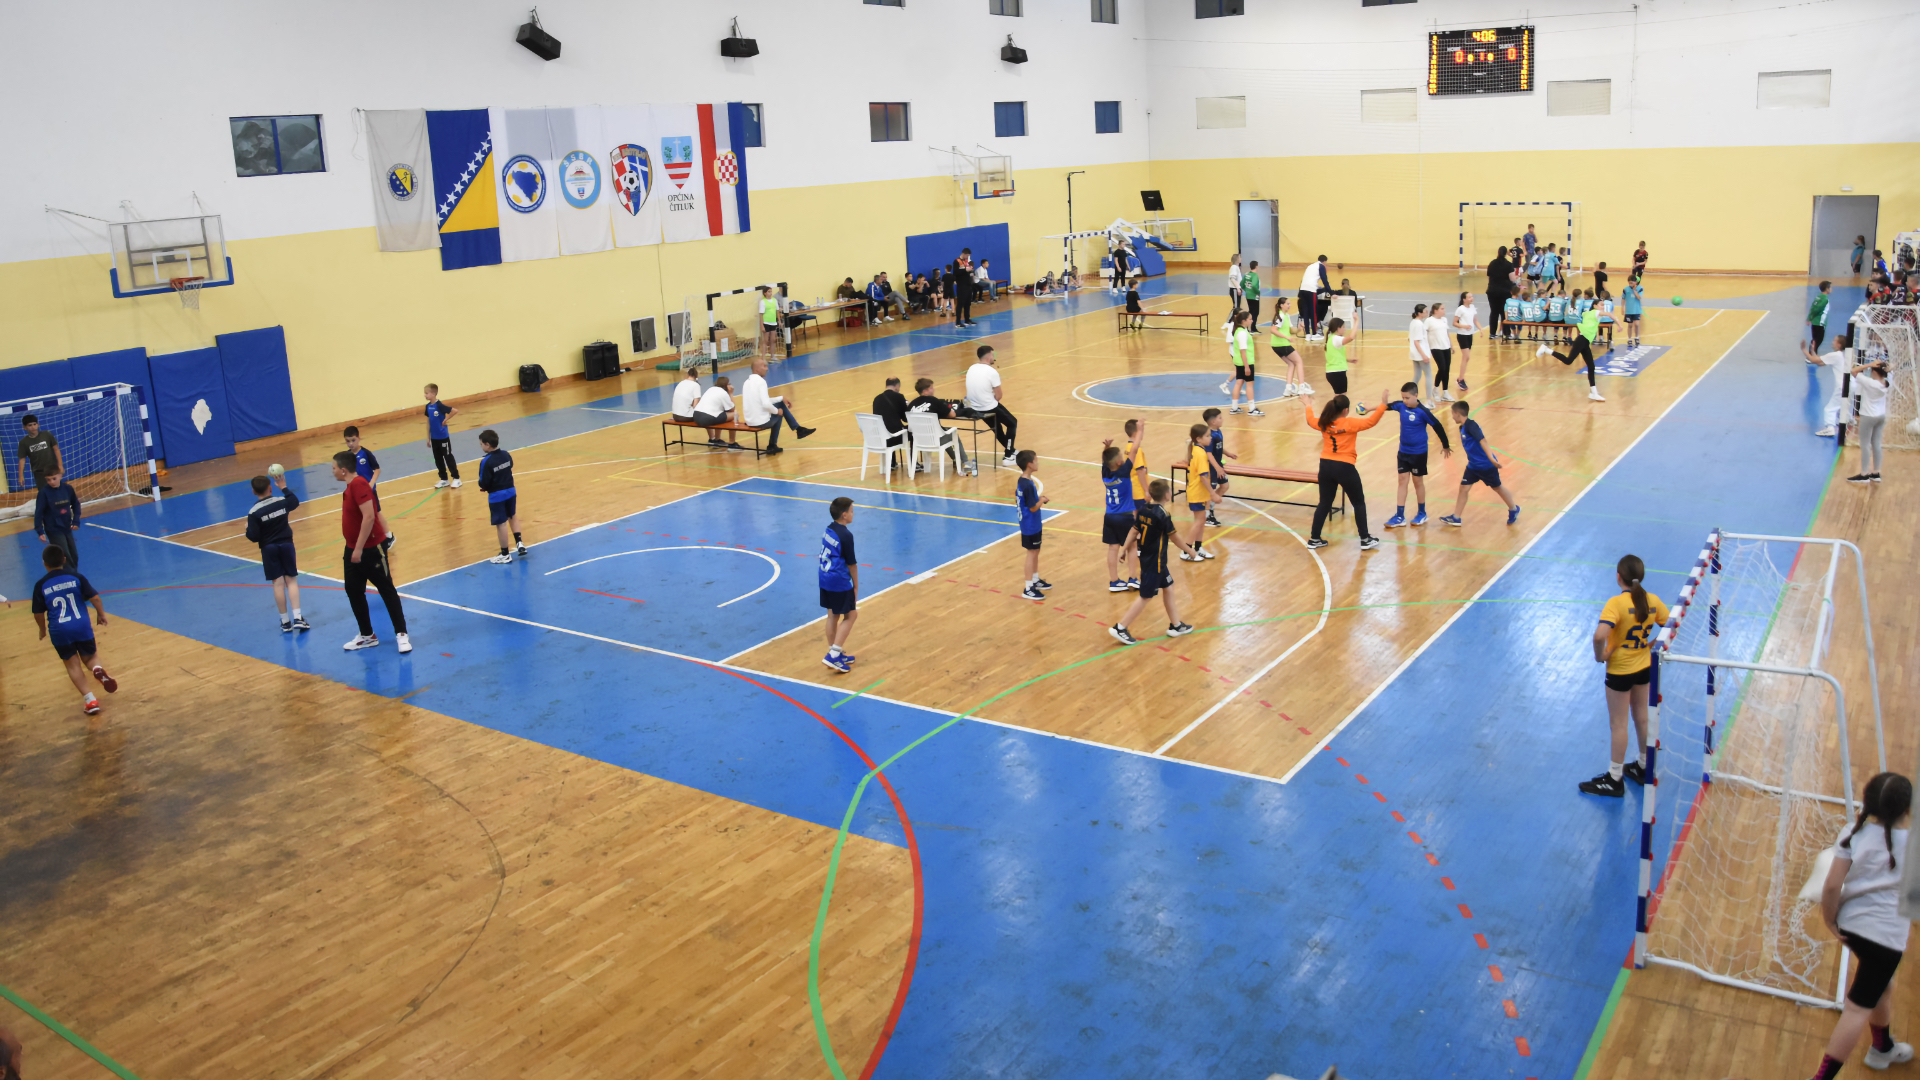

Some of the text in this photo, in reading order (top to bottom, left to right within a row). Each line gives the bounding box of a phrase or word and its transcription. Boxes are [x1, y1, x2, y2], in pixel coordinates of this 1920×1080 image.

[667, 192, 694, 202] OPĆINA
[669, 202, 695, 212] ČITLUK
[1507, 306, 1518, 317] 59
[1524, 306, 1533, 318] 10
[1550, 302, 1561, 314] 53
[1140, 523, 1148, 546] 7
[52, 593, 82, 624] 21
